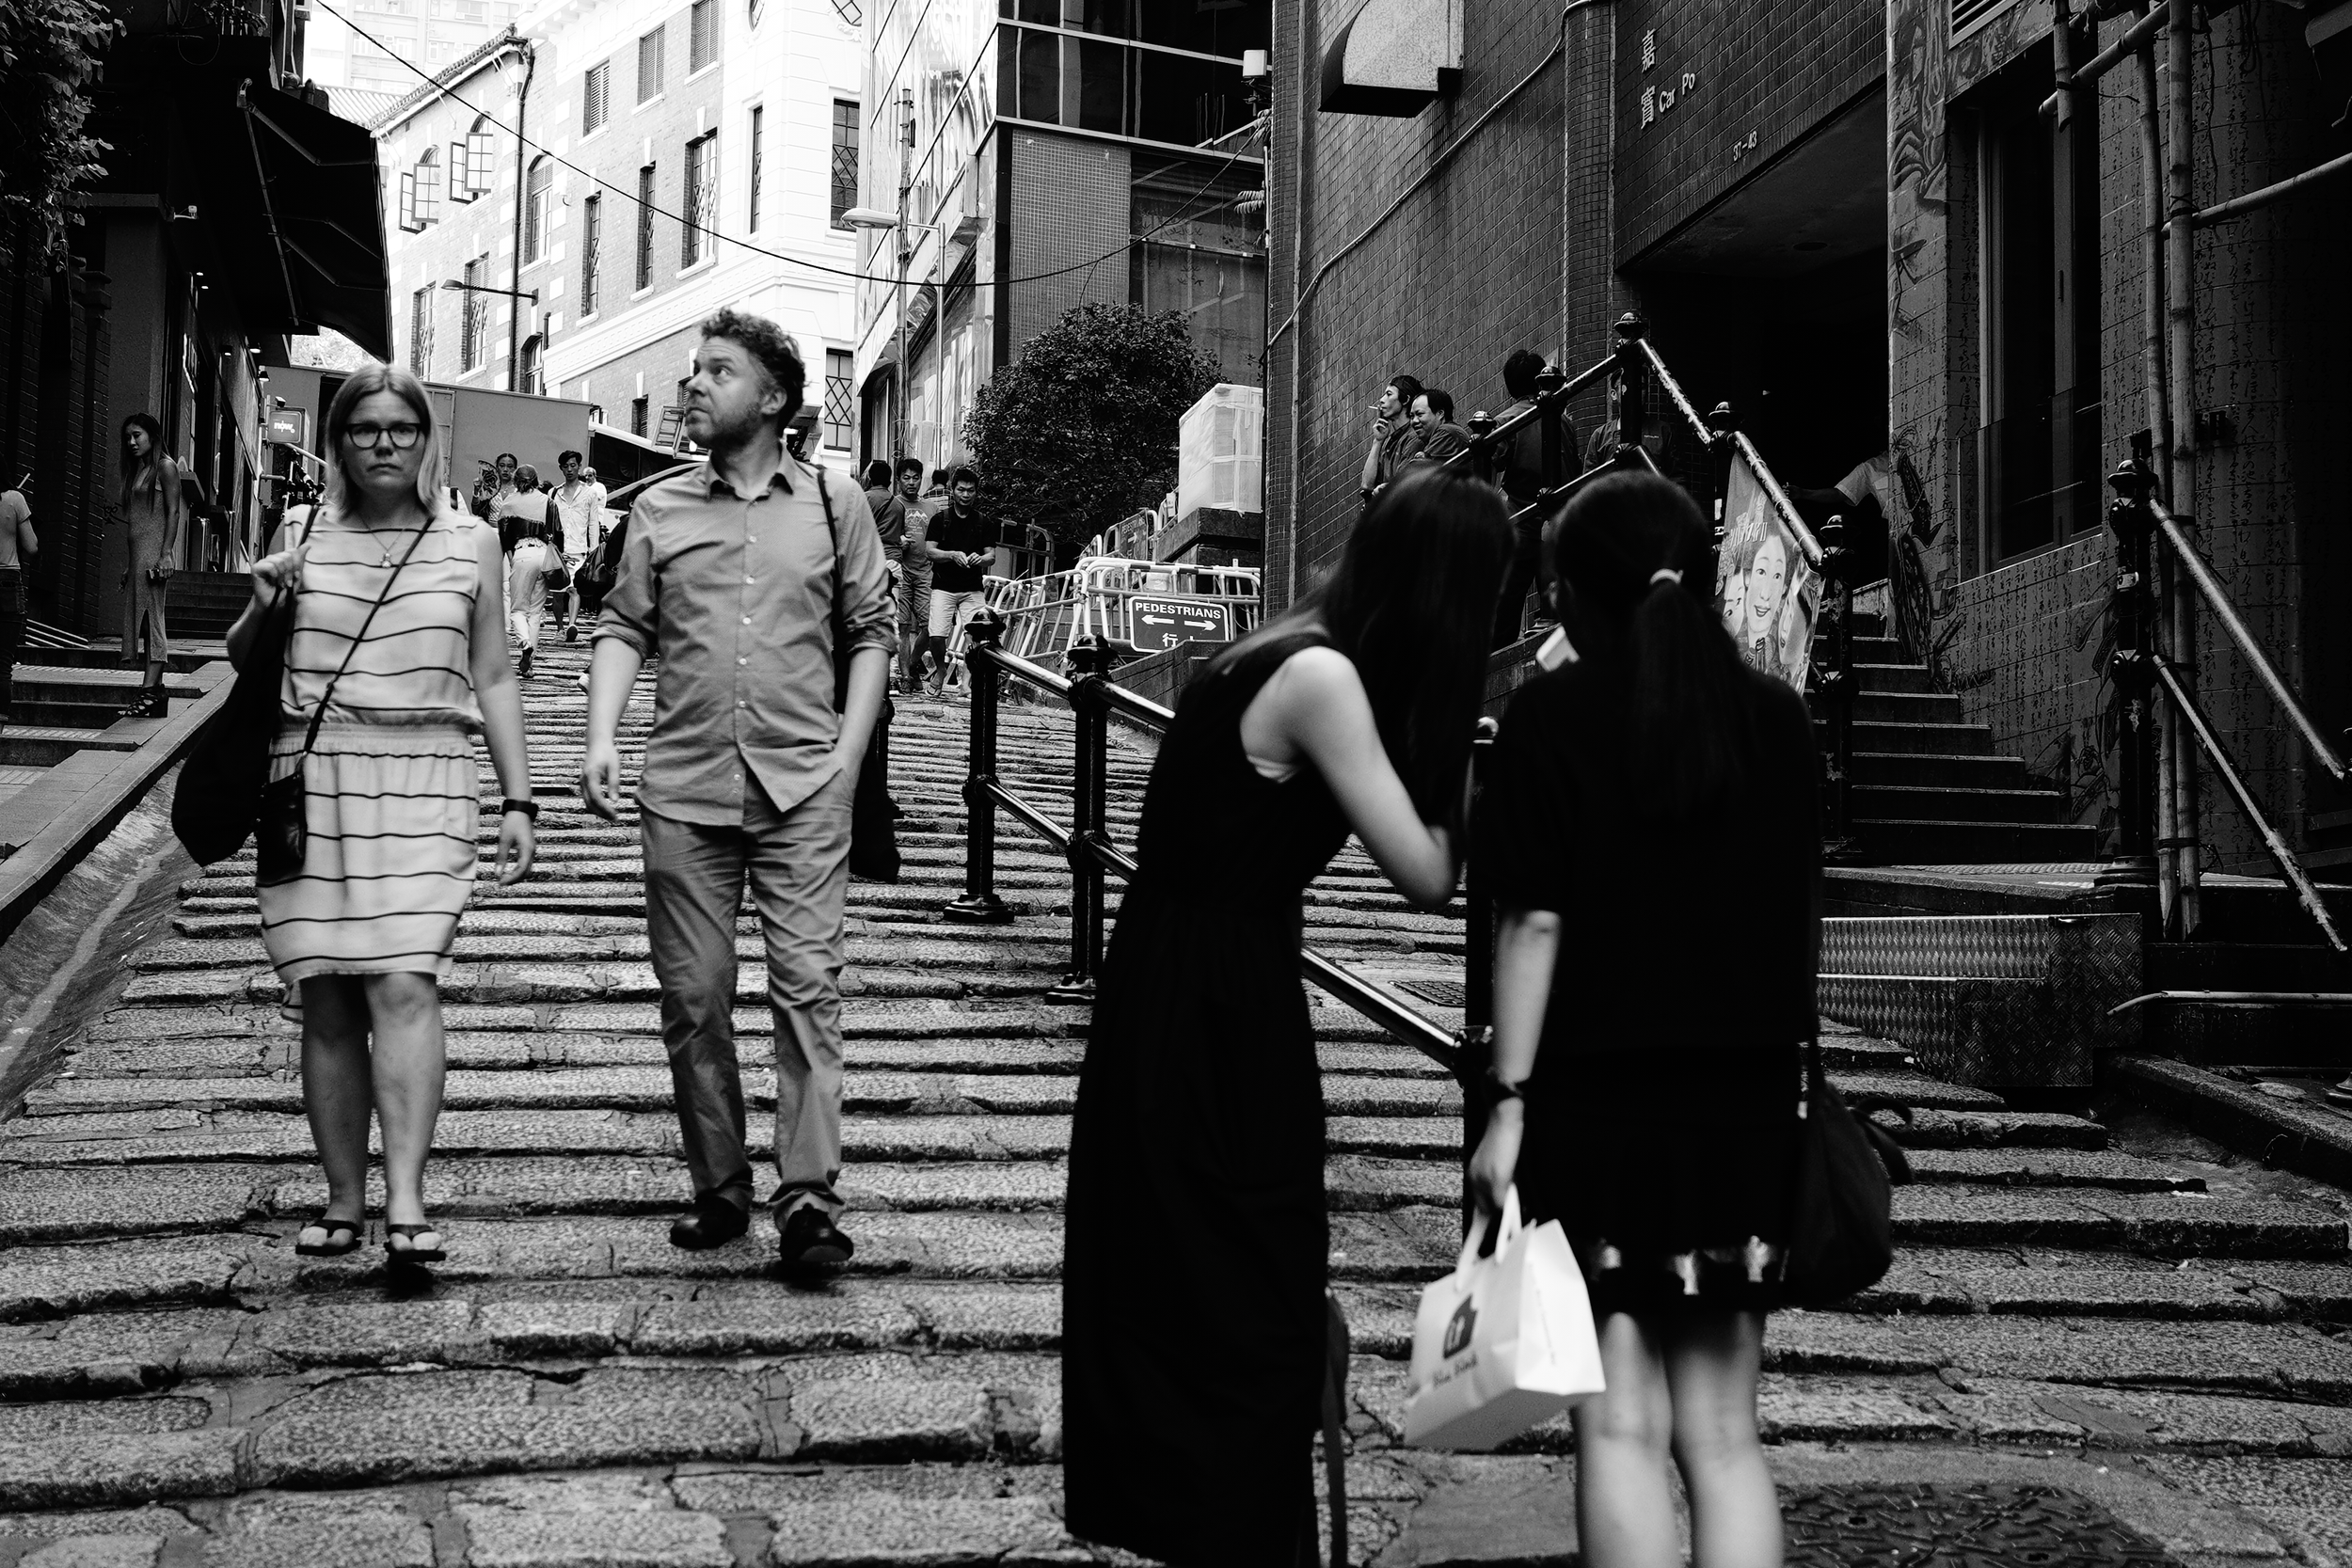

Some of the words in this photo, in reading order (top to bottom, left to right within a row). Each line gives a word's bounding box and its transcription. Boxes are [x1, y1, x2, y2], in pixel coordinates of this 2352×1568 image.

[1659, 88, 1676, 114] Car
[1682, 72, 1696, 96] Po
[1733, 130, 1758, 162] 37-43
[1136, 602, 1221, 620] PEDESTRIANS
